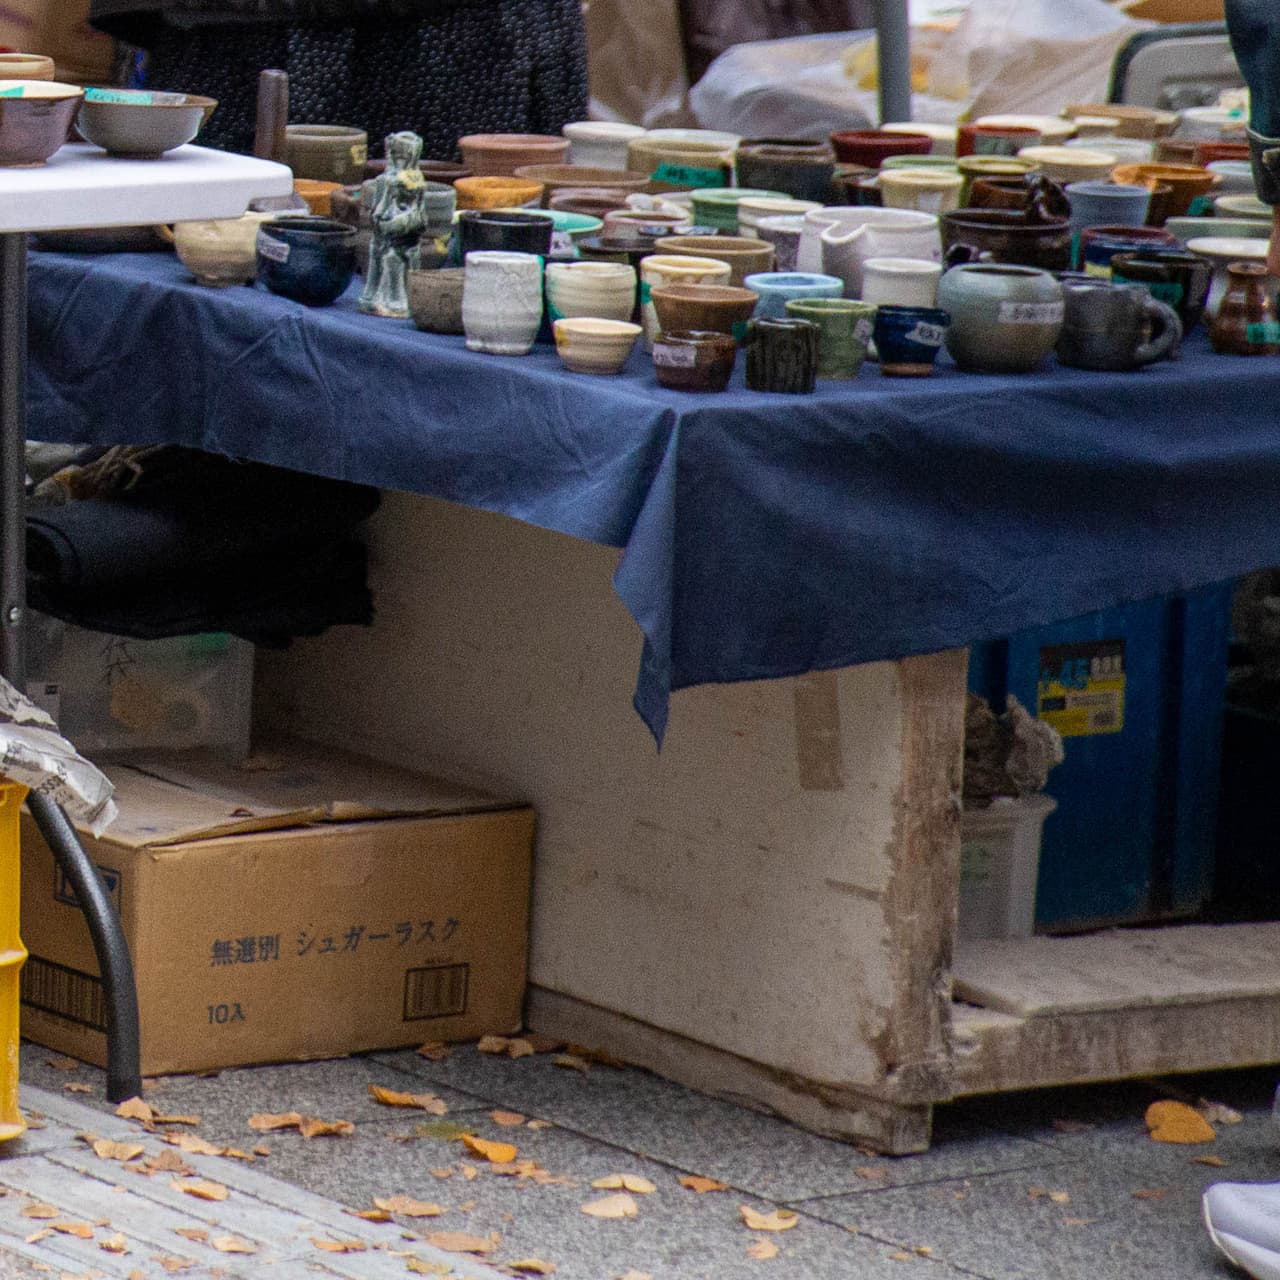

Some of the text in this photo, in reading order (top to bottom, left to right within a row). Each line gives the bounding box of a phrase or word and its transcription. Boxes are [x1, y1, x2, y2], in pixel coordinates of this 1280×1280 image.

[210, 916, 461, 968] 無選別 シュガーラスク
[207, 1002, 246, 1025] 10入
